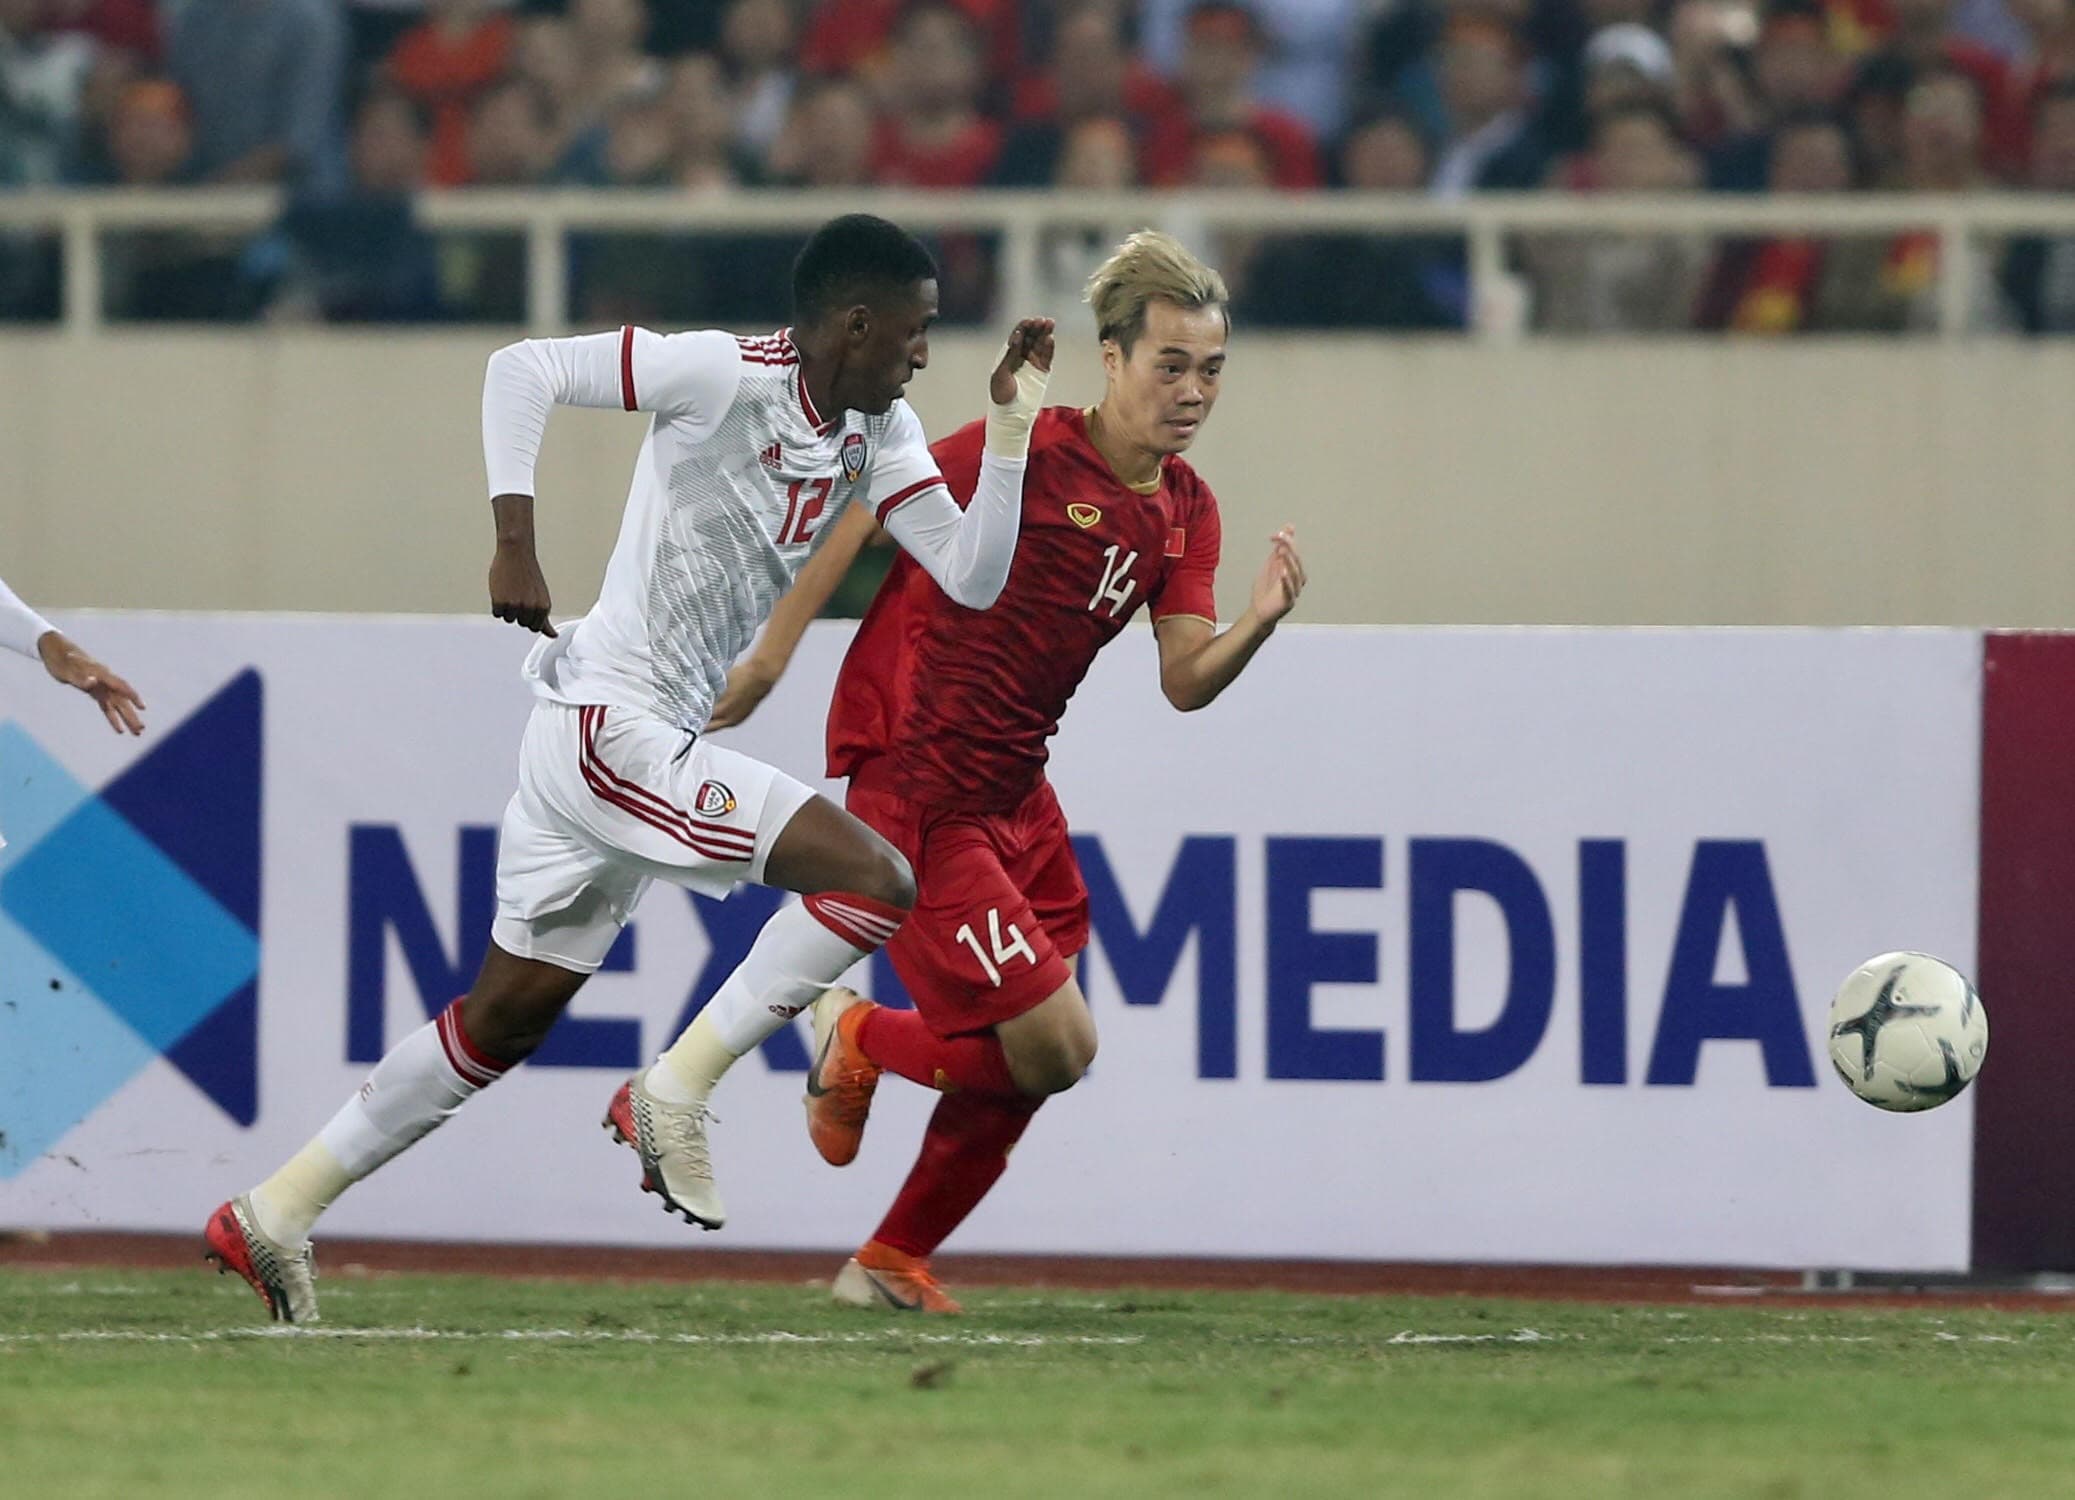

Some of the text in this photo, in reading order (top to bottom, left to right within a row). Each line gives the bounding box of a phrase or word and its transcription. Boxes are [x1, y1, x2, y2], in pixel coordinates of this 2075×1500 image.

[776, 478, 834, 544] 12
[1088, 544, 1138, 617] 14
[346, 824, 1818, 1088] NX MEDIA
[956, 908, 1037, 987] 14
